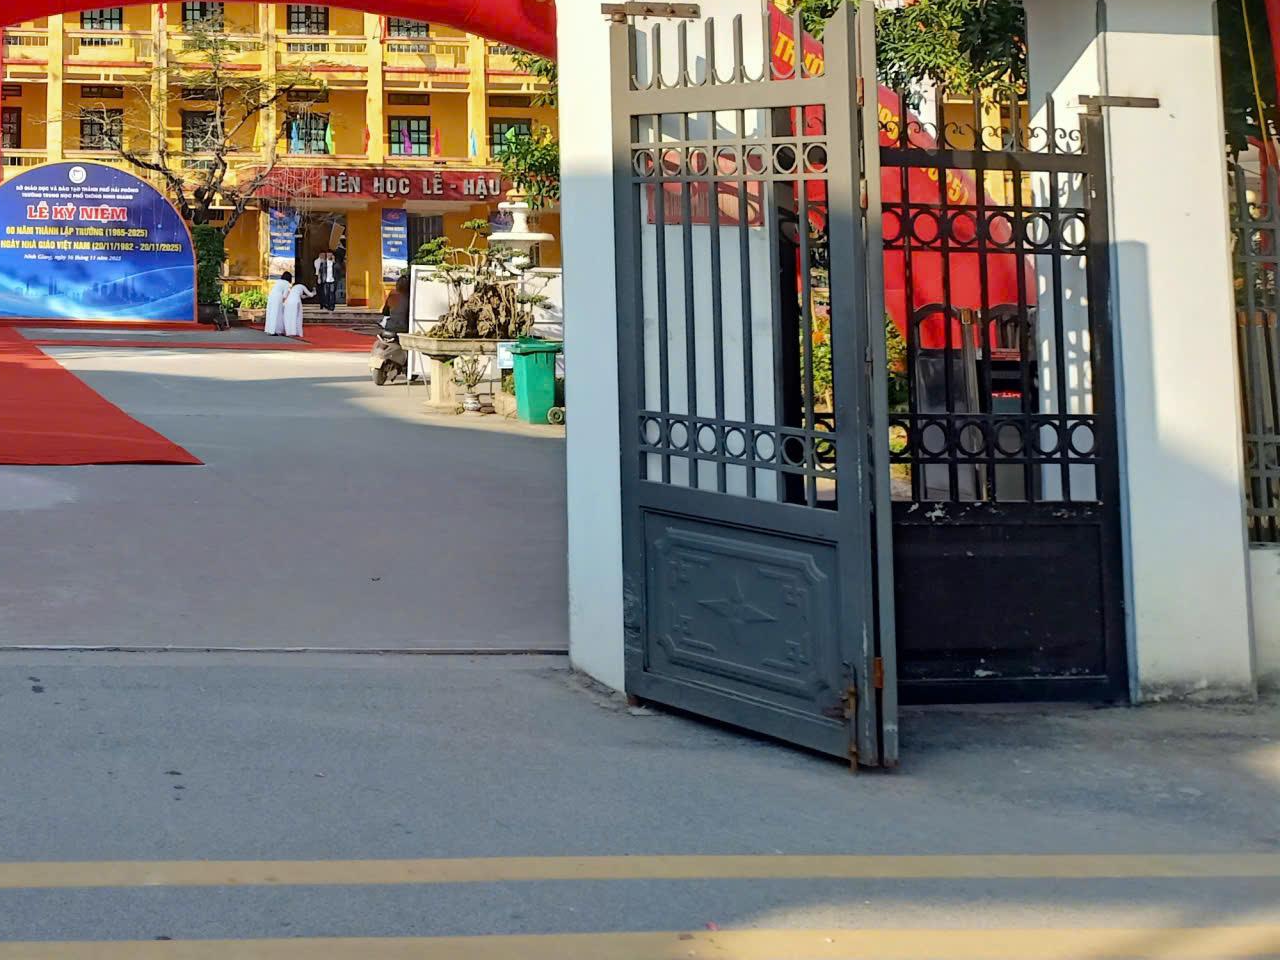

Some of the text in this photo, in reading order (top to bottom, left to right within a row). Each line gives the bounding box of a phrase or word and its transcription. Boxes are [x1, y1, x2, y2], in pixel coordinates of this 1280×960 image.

[321, 171, 361, 193] TIÊN
[373, 176, 410, 198] HỌC
[422, 171, 443, 195] LỄ
[463, 176, 501, 199] HẬU
[27, 201, 49, 219] LỄ
[79, 204, 127, 223] NIỆM
[16, 225, 33, 235] NĂM
[35, 226, 58, 235] THÀNH
[60, 226, 74, 237] LẬP
[1, 239, 20, 248] NGÀY
[56, 240, 72, 251] VIỆT
[73, 241, 90, 250] NAM
